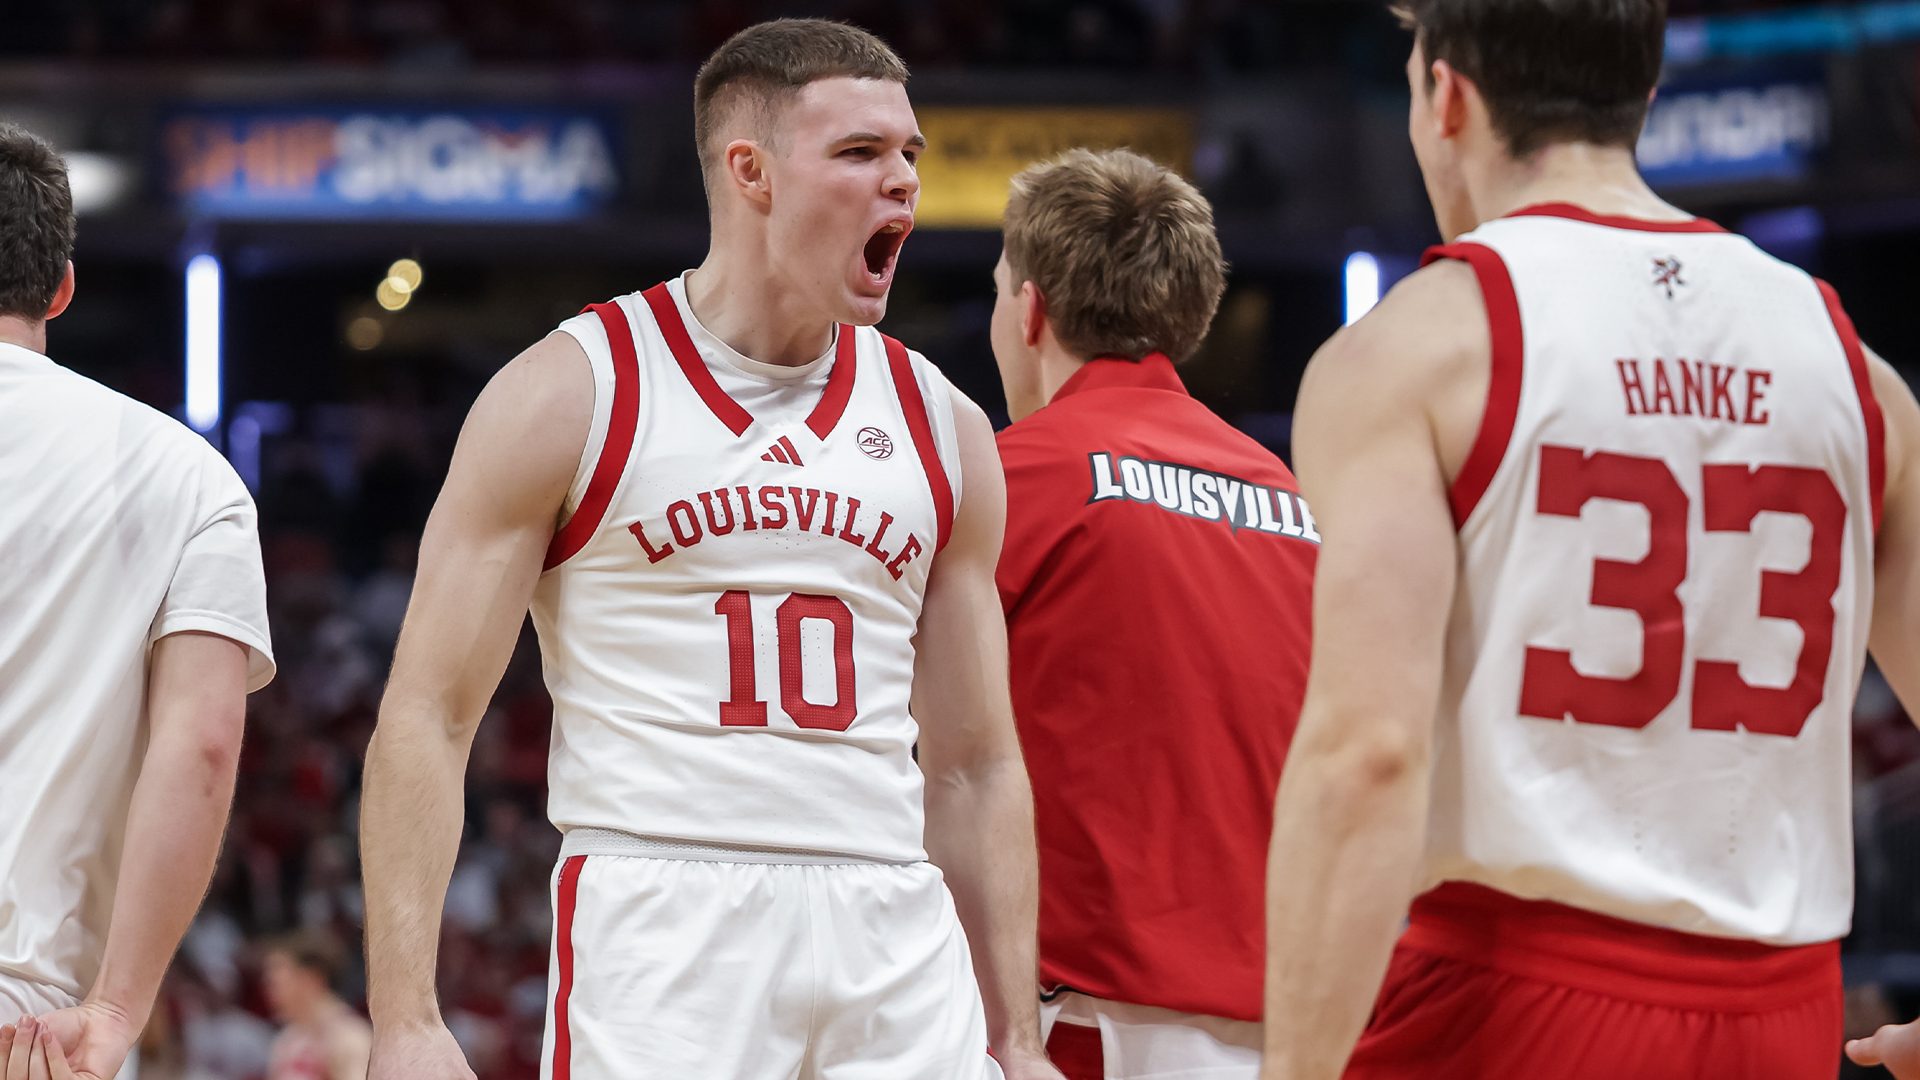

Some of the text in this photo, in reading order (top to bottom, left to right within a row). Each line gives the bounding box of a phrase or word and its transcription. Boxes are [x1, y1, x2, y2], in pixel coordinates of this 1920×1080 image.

[1615, 358, 1772, 426] HANKE
[861, 437, 890, 447] ACC
[628, 485, 922, 581] LOUISVILLE
[1088, 453, 1321, 544] LOUISVILLE
[1518, 444, 1849, 738] 33
[715, 589, 858, 732] 10
